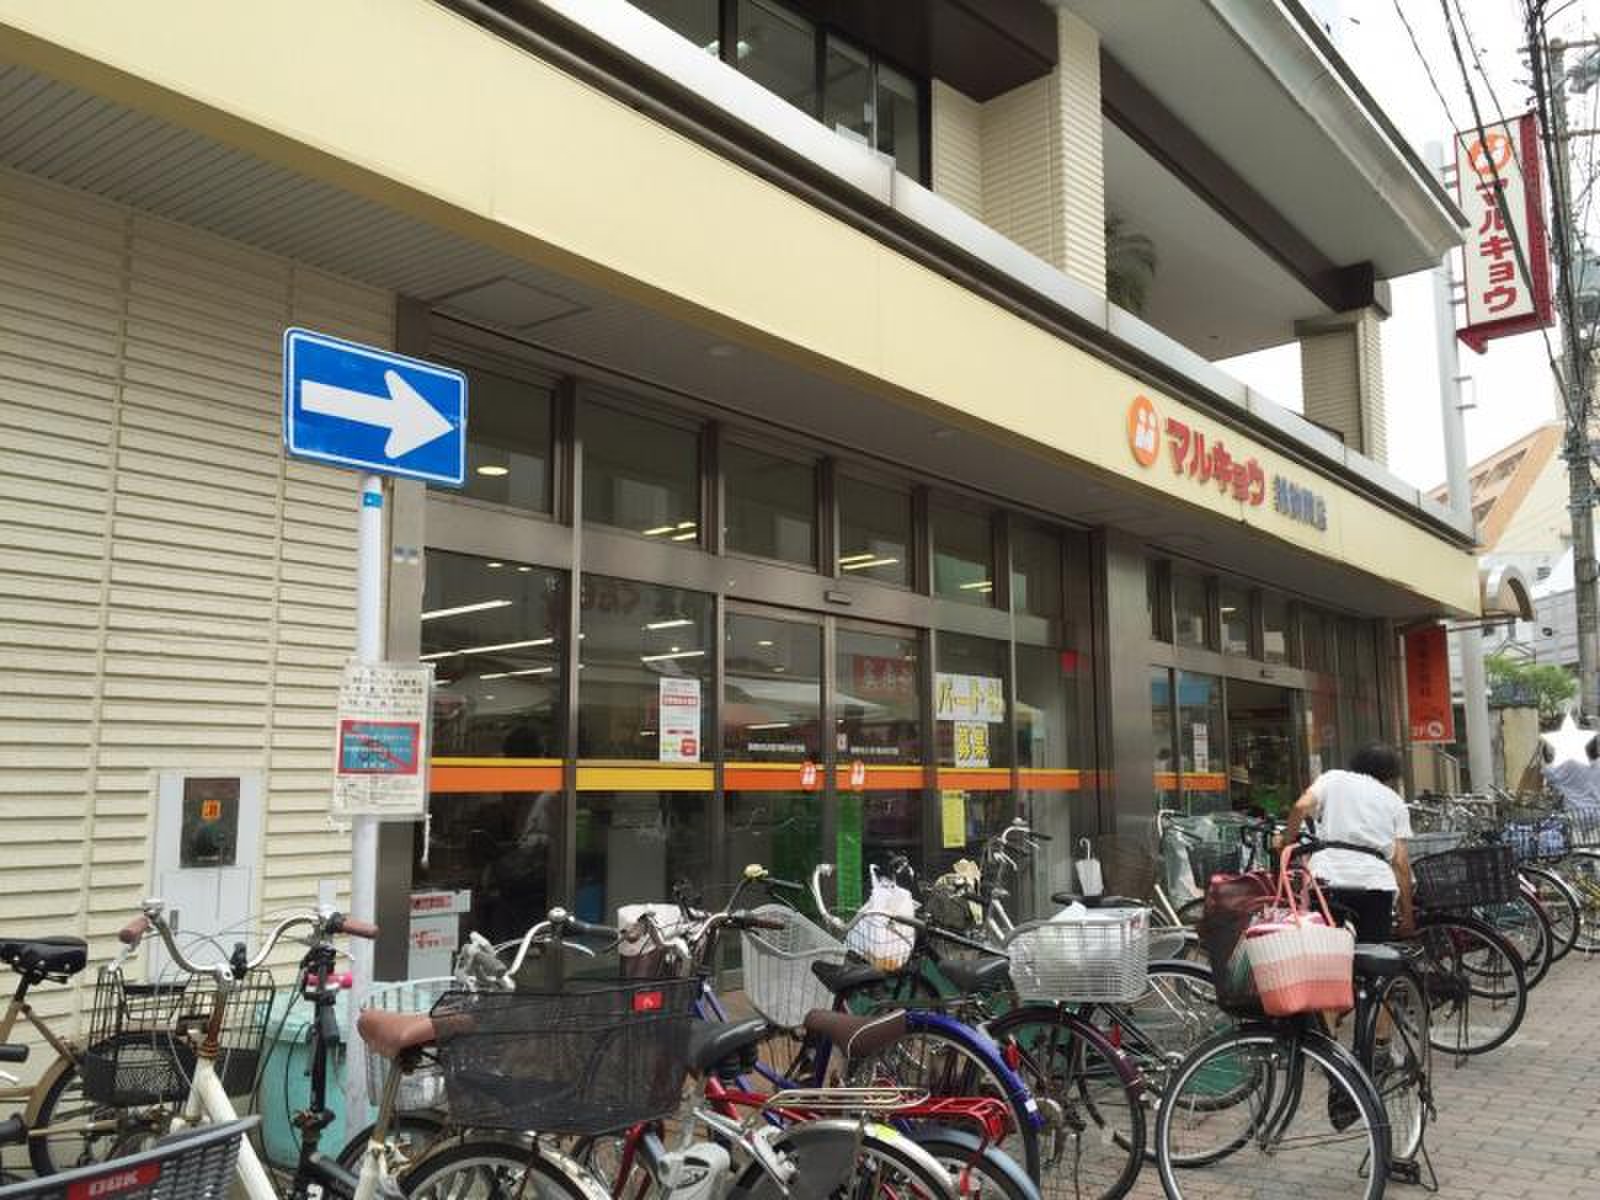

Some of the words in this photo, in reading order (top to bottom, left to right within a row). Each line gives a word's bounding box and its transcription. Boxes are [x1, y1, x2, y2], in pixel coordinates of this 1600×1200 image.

[1475, 178, 1518, 314] マルキョウ
[1164, 415, 1266, 506] マルキョウ
